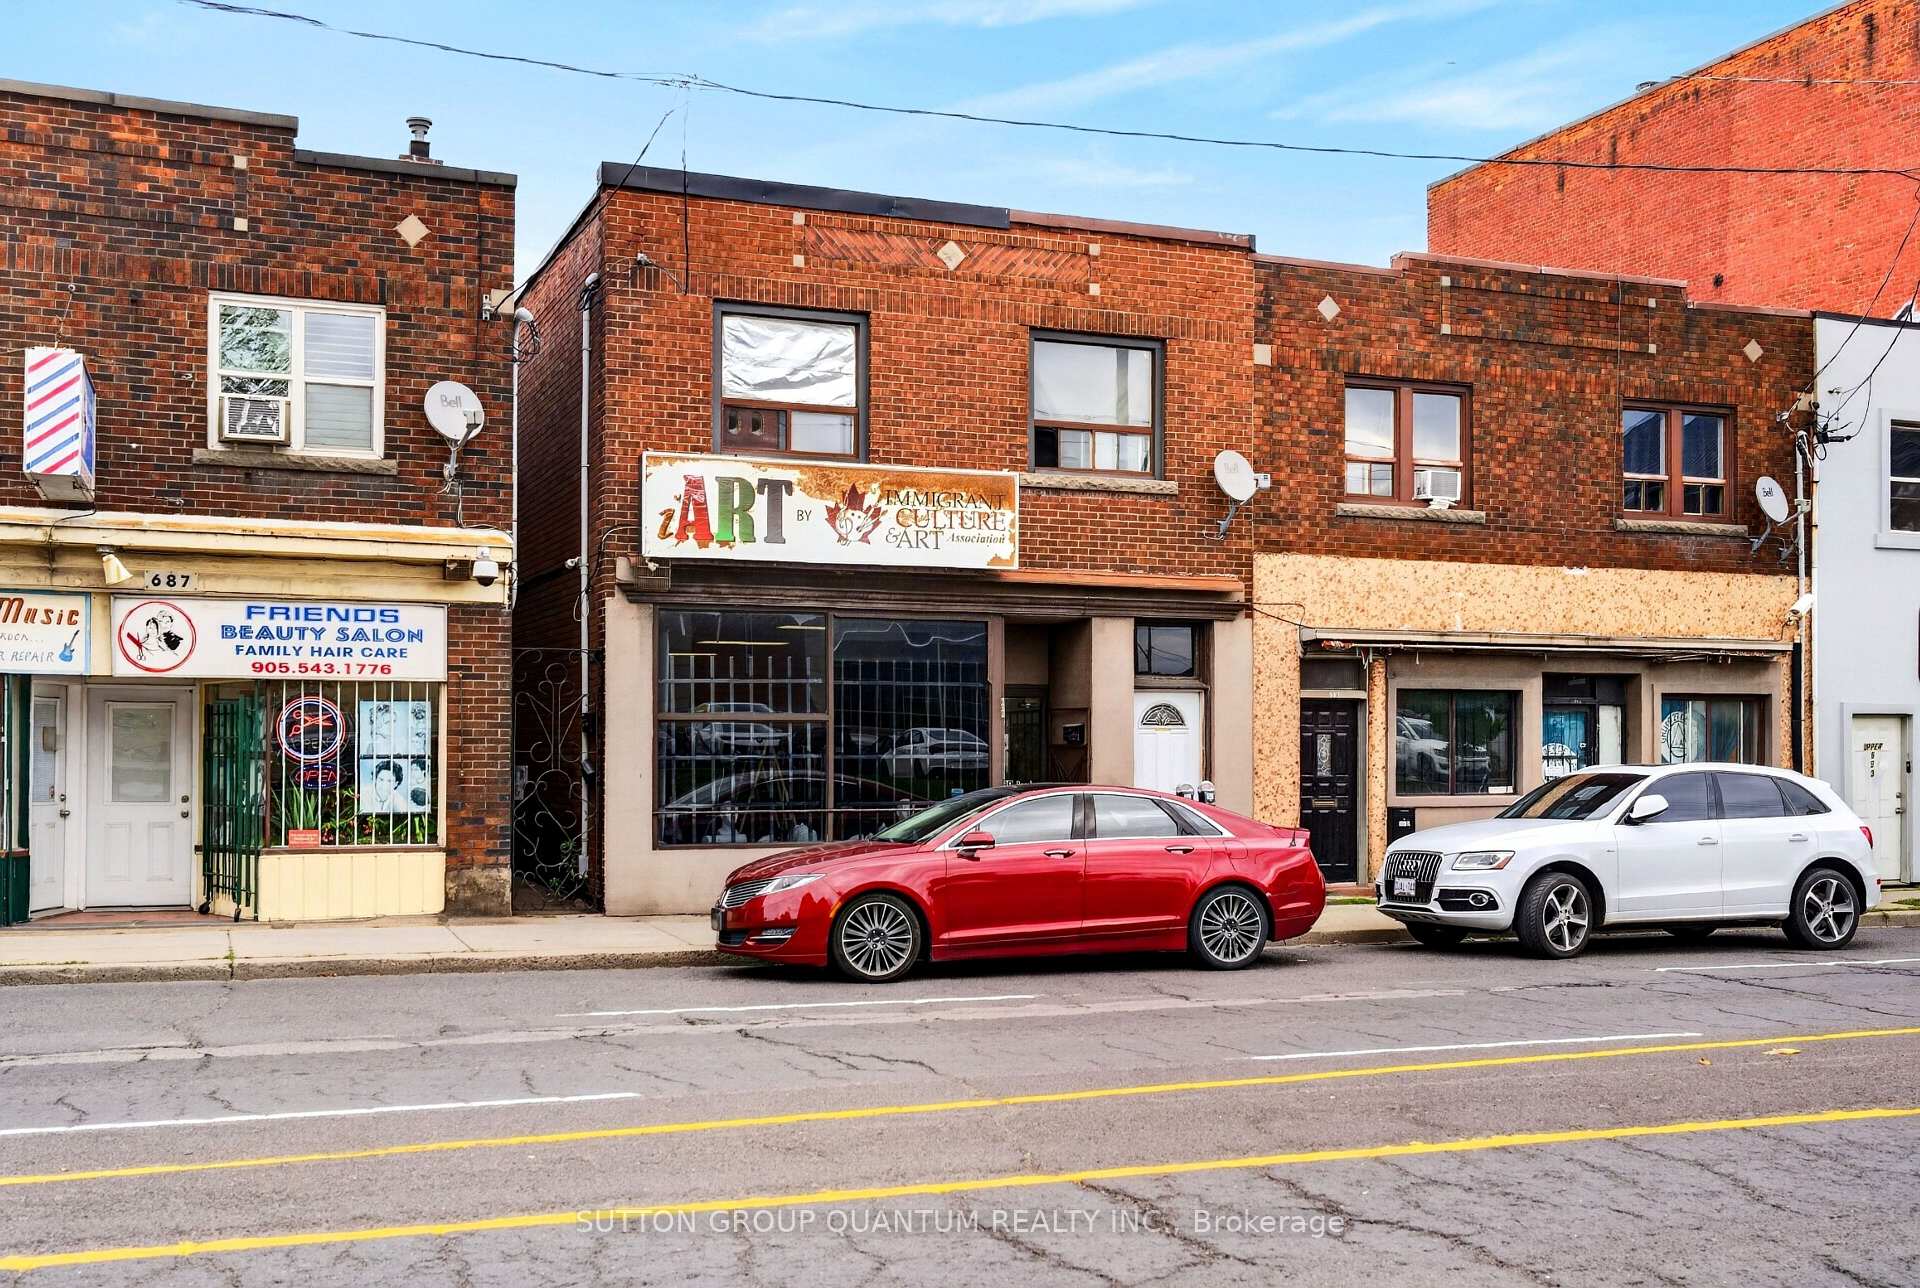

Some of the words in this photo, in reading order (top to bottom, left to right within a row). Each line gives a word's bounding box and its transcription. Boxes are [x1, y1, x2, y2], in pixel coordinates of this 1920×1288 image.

[440, 394, 462, 409] Bell
[885, 489, 1006, 511] IMMIGRANT
[796, 509, 812, 522] BY
[896, 507, 1006, 532] CULTURE
[151, 573, 190, 588] 687
[245, 605, 399, 624] FRIENDS
[220, 625, 326, 642] BEAUTY
[335, 627, 424, 643] SALON
[11, 650, 54, 663] REPAIR
[235, 644, 303, 657] FAMILY
[310, 646, 354, 658] HAIR
[360, 647, 408, 659] CARE
[251, 661, 392, 675] 905.543.1776
[295, 769, 338, 783] OPEN
